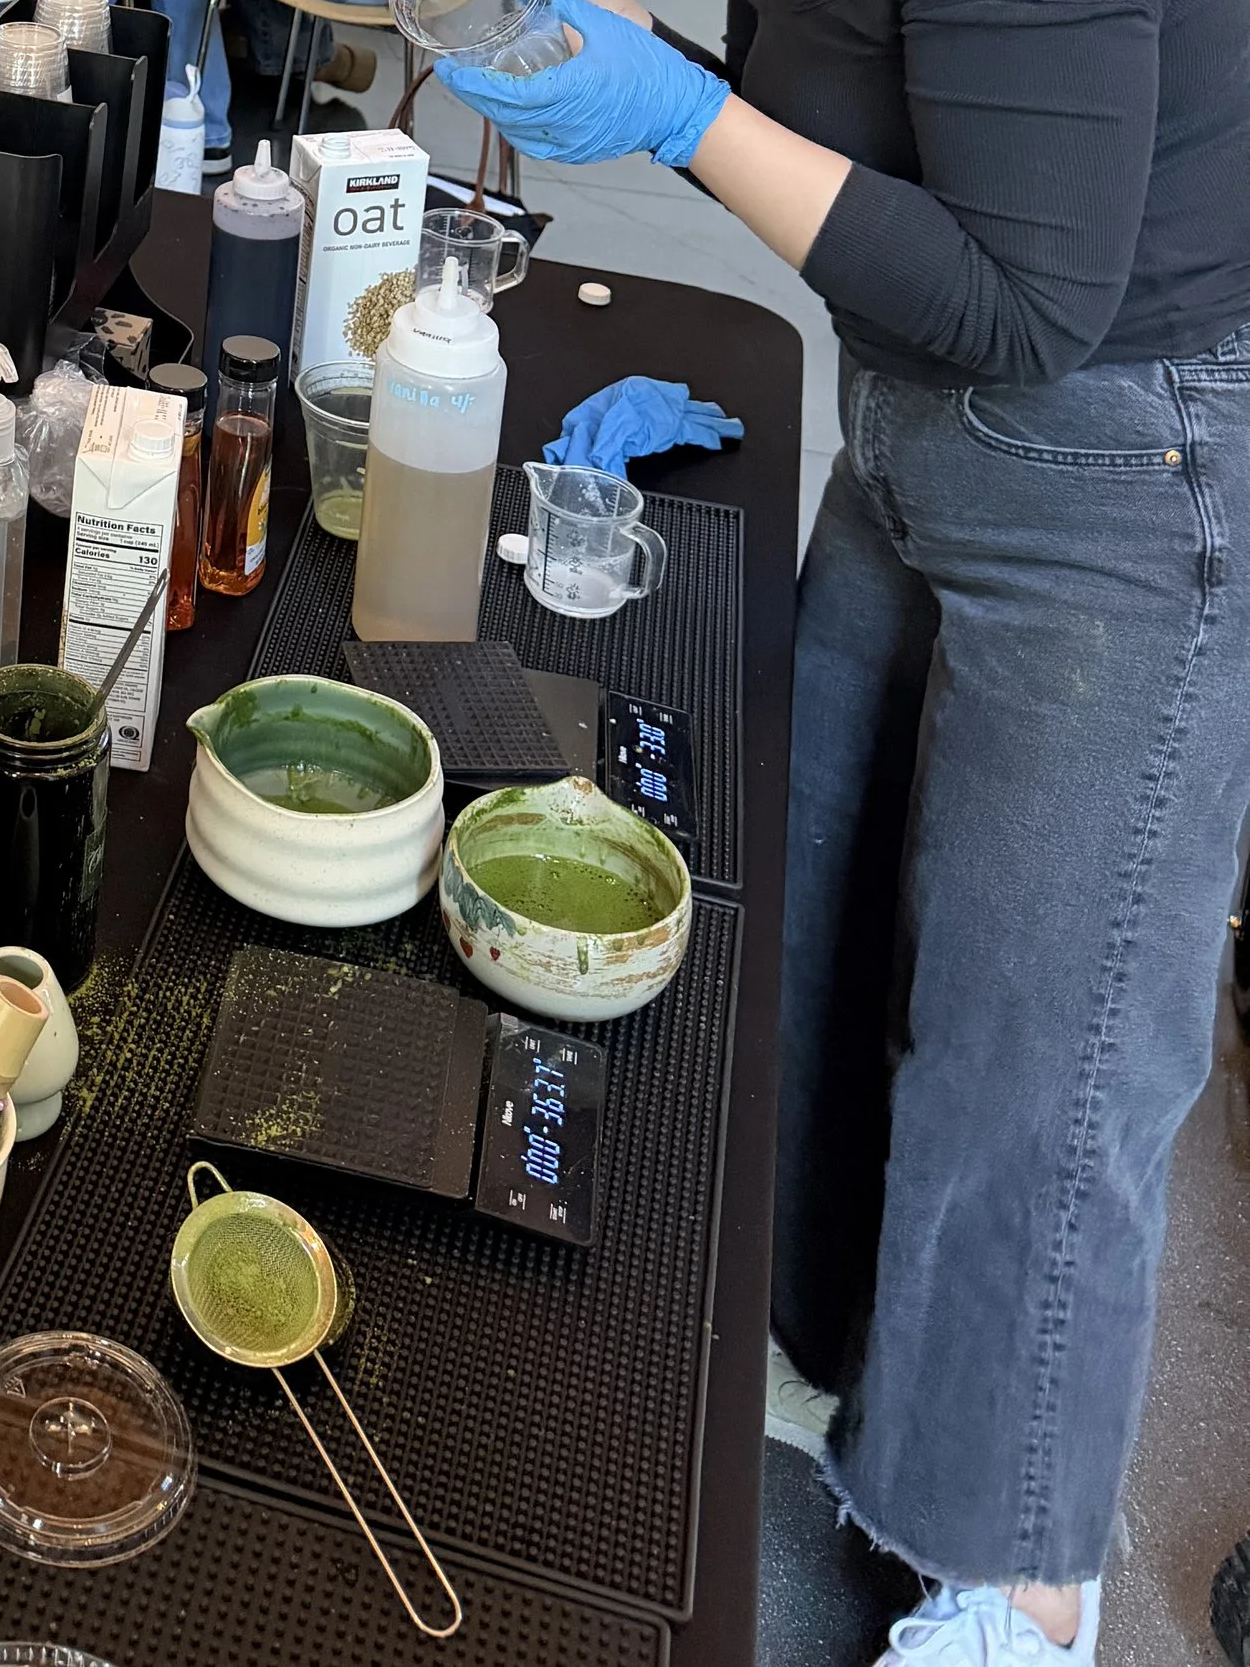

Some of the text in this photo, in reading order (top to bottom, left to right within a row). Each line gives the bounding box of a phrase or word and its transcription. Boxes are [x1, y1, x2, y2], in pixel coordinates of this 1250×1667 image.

[350, 176, 398, 187] KIRKLAND
[333, 198, 406, 236] oat
[382, 240, 410, 248] BEVERAGE
[78, 515, 156, 534] Nutrition Facts
[76, 531, 98, 540] Serving
[75, 548, 158, 565] Calories 130
